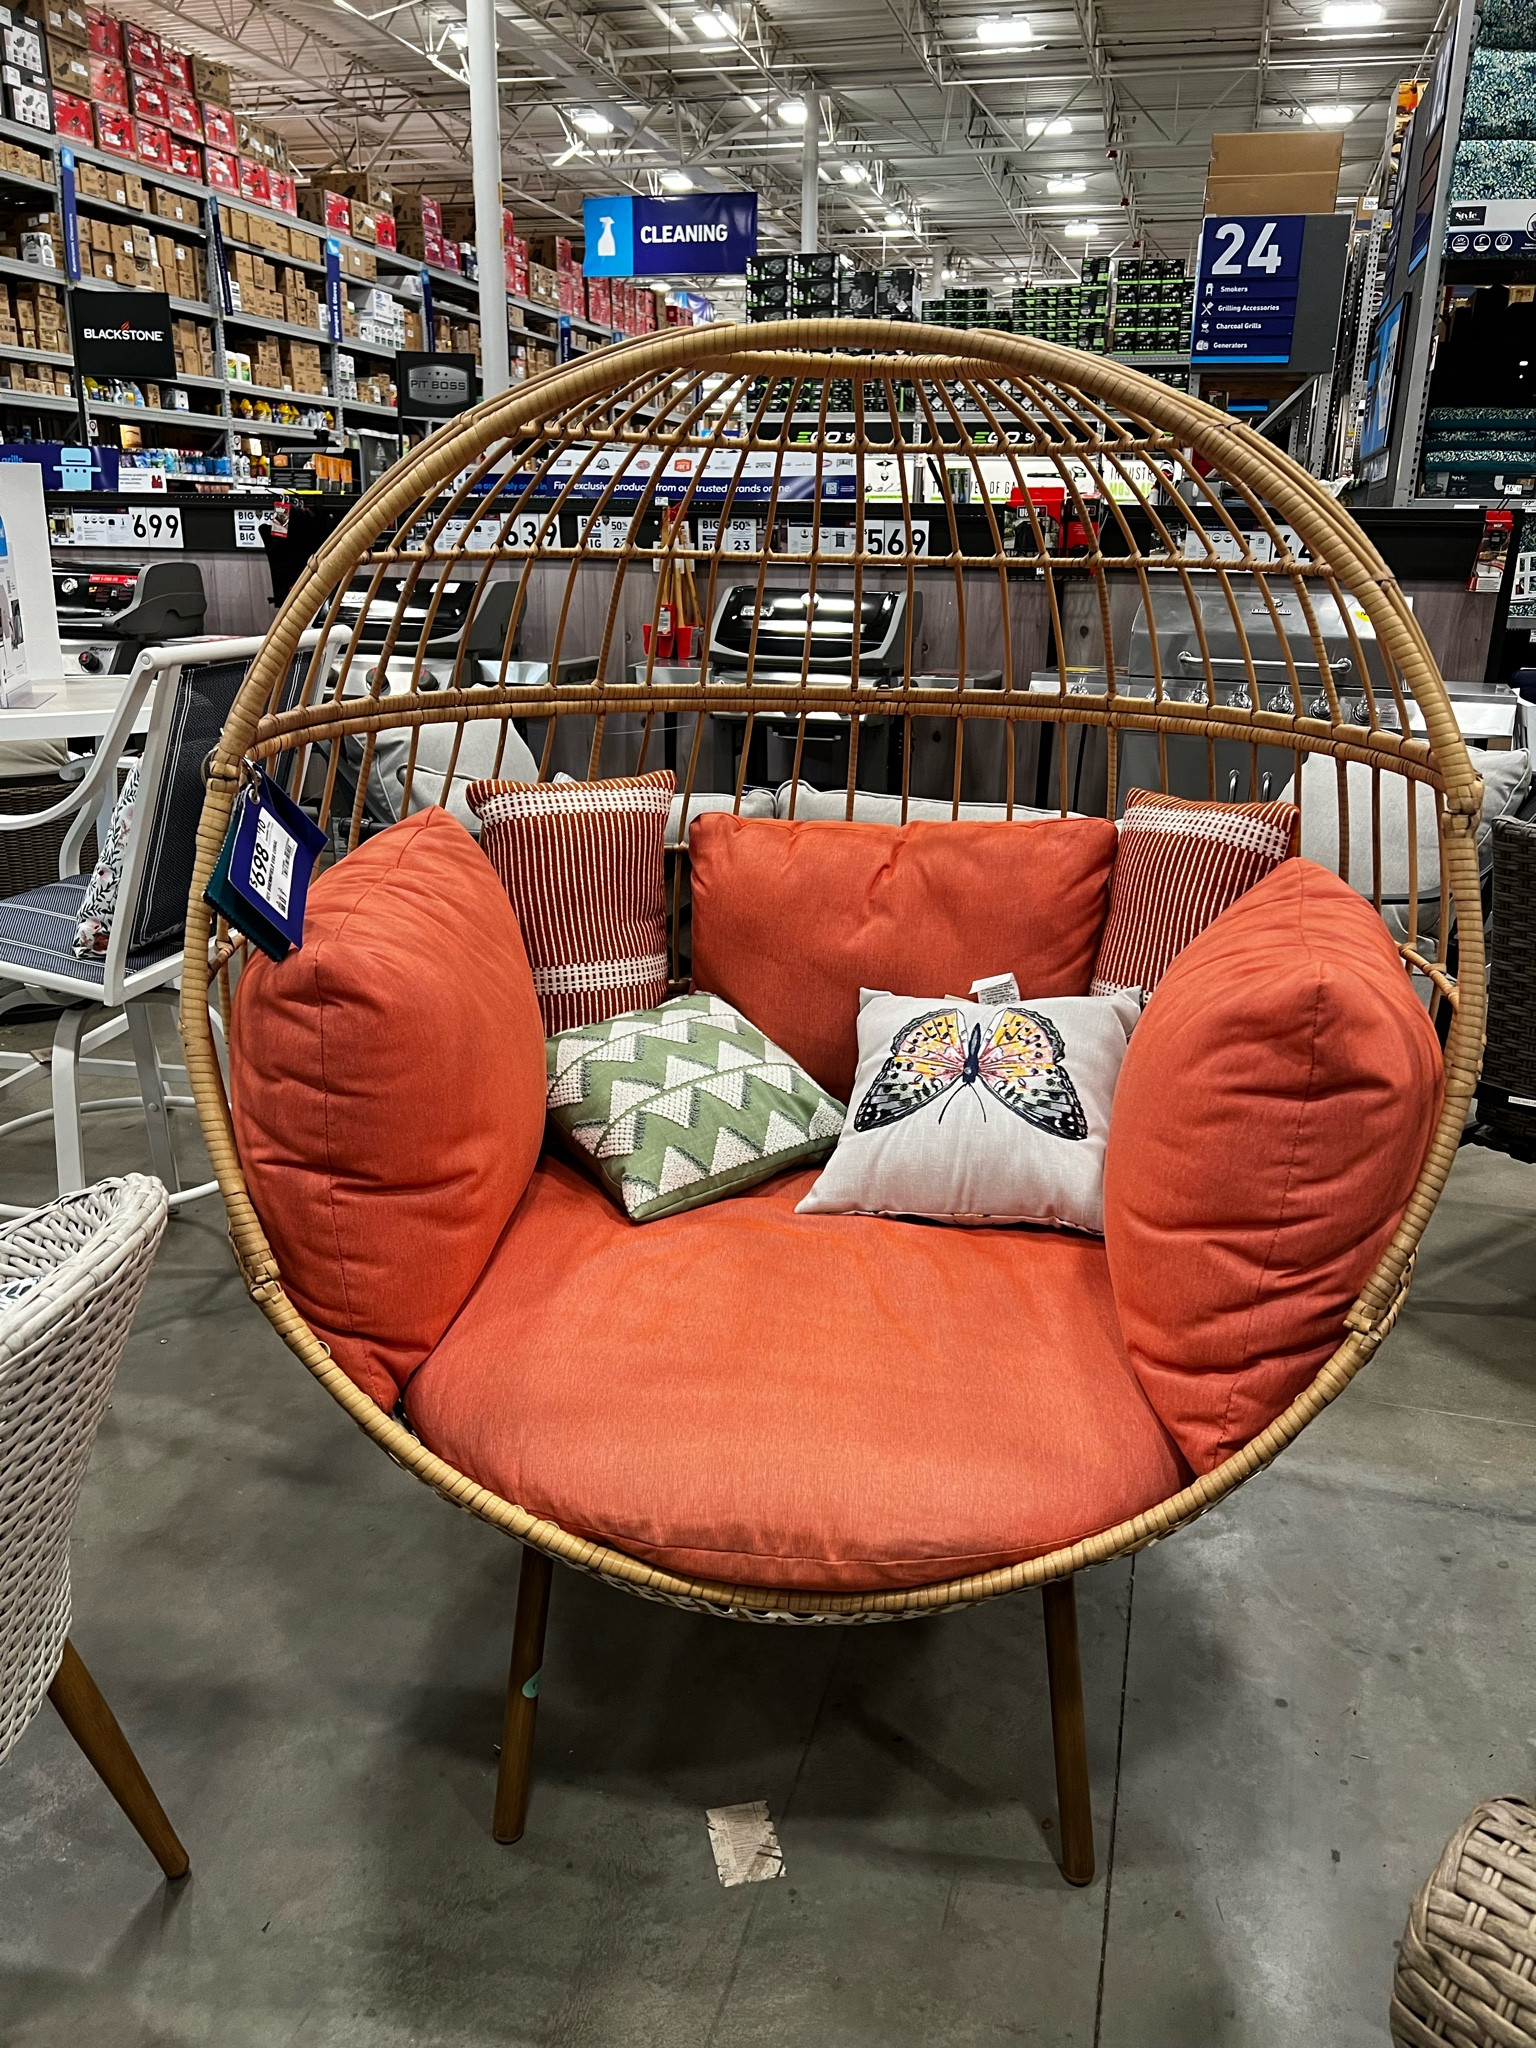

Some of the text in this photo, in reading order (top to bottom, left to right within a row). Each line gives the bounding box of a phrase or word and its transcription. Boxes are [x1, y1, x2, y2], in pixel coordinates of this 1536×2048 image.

[1455, 211, 1478, 221] Style
[640, 224, 728, 243] CLEANING
[1211, 222, 1282, 275] 24
[1217, 304, 1280, 313] Grilling Accessories
[1216, 322, 1244, 330] Charcoal
[83, 328, 164, 342] BLACKSTONE
[411, 380, 466, 391] PIT BOSS
[553, 481, 569, 490] Fin
[573, 481, 611, 490] exclusiv
[613, 483, 648, 492] produc
[655, 482, 677, 492] from
[695, 483, 728, 493] trusted
[735, 484, 761, 493] rands
[989, 481, 1001, 494] OF
[238, 512, 254, 520] BIG
[132, 514, 179, 538] $699
[581, 518, 628, 530] BG 50%
[702, 520, 751, 531] BIG 50%
[239, 532, 255, 541] BIG
[503, 521, 558, 547] 639
[864, 528, 926, 556] $569
[249, 842, 269, 889] $698
